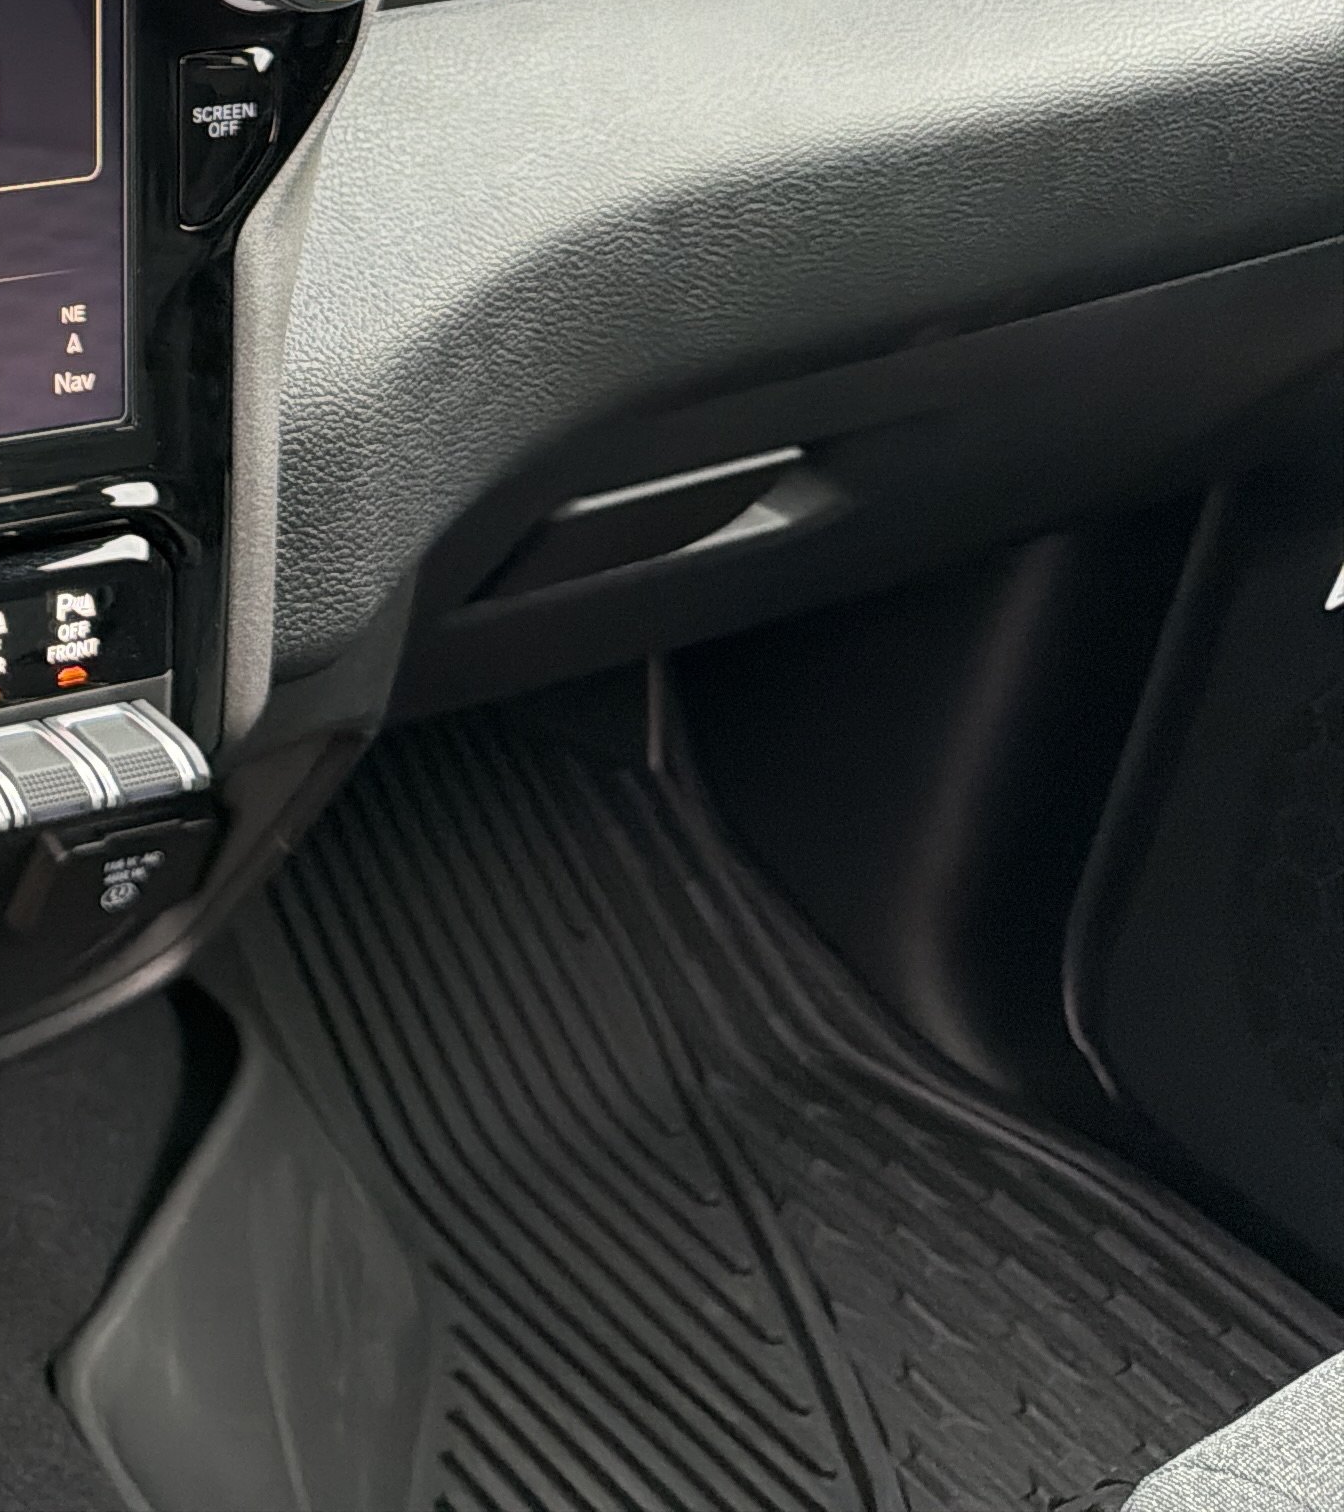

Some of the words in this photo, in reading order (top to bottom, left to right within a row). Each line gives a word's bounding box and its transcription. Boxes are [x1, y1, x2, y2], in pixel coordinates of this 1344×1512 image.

[192, 103, 257, 124] SCREEN
[208, 122, 239, 137] OFF
[61, 305, 87, 324] NE
[54, 373, 96, 395] Nav
[57, 620, 90, 643] OFF
[46, 638, 100, 664] FRONT
